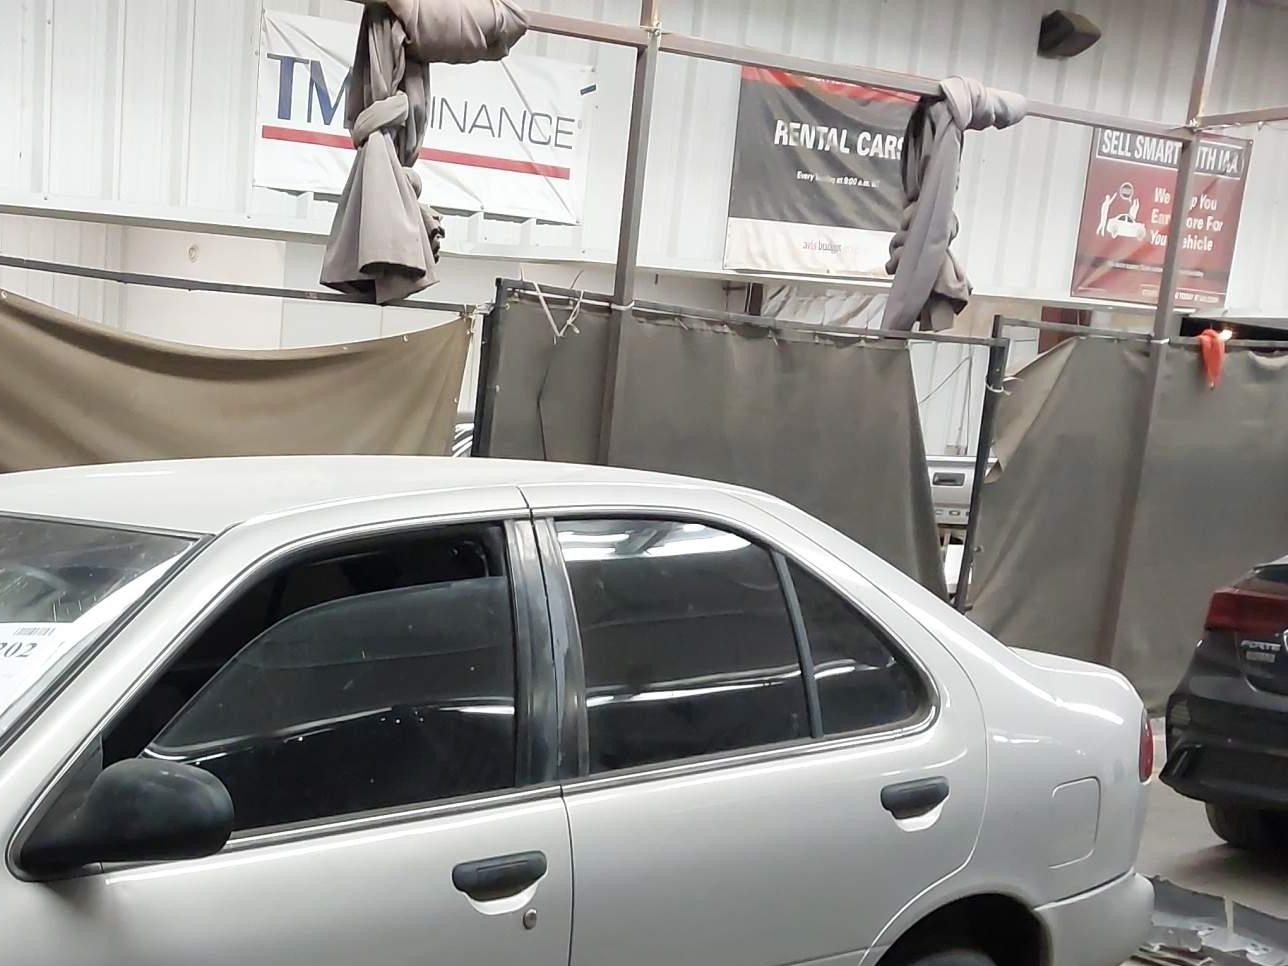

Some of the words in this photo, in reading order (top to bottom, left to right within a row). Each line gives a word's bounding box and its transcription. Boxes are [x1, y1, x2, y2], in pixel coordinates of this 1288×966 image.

[431, 97, 576, 150] INANCE
[774, 119, 850, 154] RENTAL
[1102, 129, 1131, 157] SELL
[1134, 135, 1183, 165] SMART
[1195, 146, 1217, 170] ITH
[1154, 187, 1171, 204] We
[1199, 193, 1217, 210] You
[1186, 217, 1204, 230] ore
[1206, 215, 1223, 231] For
[1182, 234, 1214, 251] ehicle
